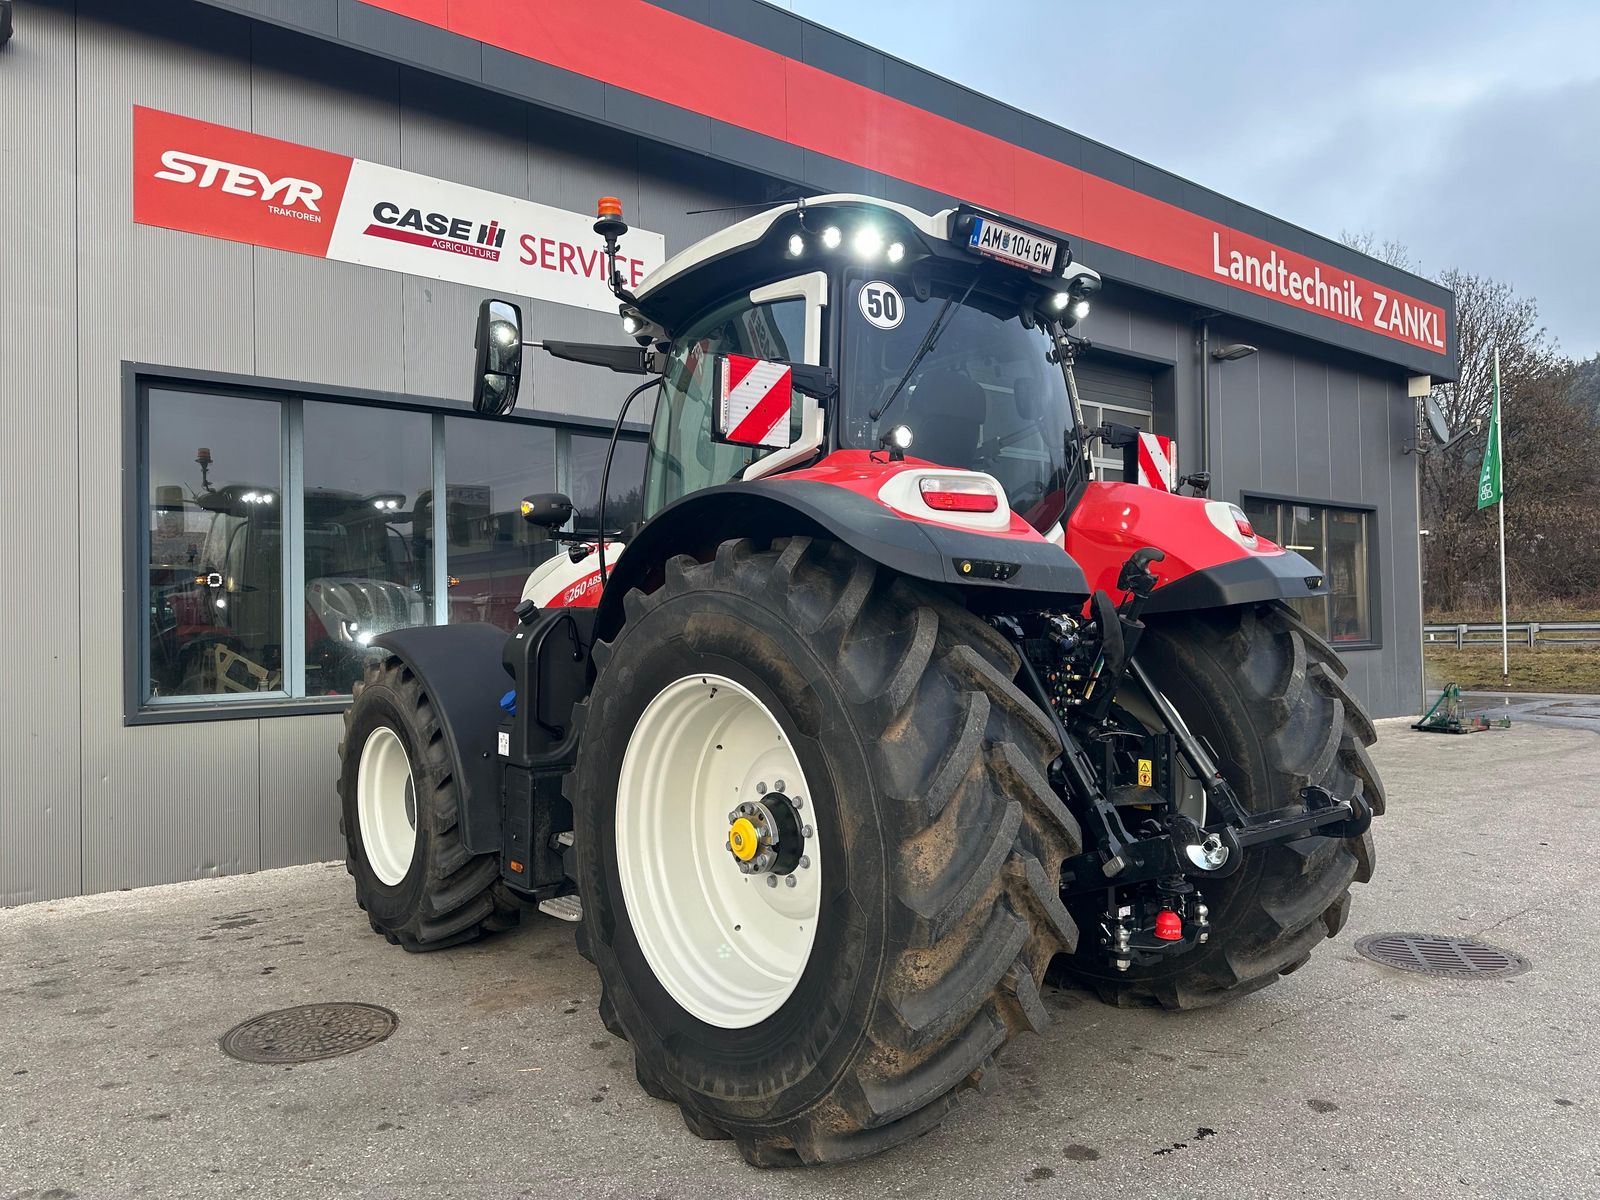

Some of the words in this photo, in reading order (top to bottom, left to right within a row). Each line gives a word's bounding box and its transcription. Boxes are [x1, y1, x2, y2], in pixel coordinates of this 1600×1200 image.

[153, 150, 323, 212] STEYR
[267, 205, 322, 223] TRAKTOREN
[372, 201, 473, 241] CASE
[431, 239, 497, 260] AGRICULTURE
[981, 225, 1003, 250] AM
[1012, 234, 1031, 260] 104
[1033, 242, 1053, 266] GW
[866, 288, 898, 321] 50
[1213, 231, 1363, 322] Landtechnik
[1373, 291, 1444, 348] ZANKL
